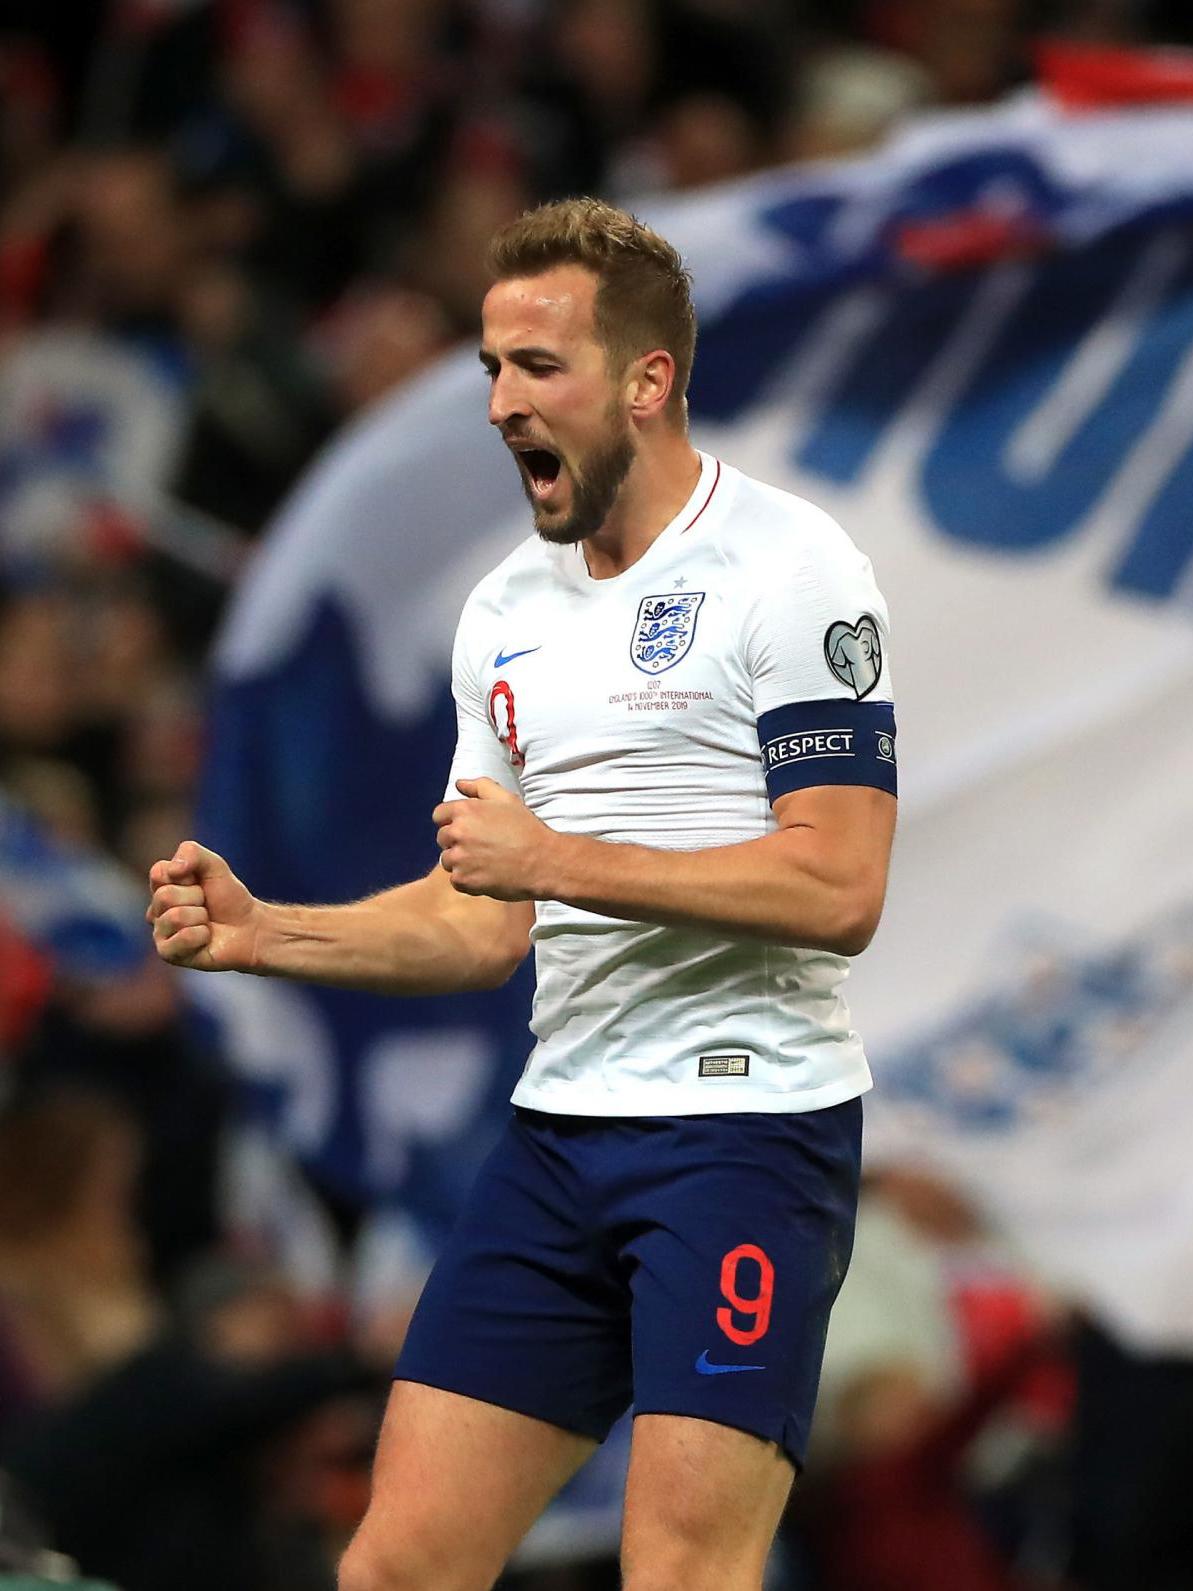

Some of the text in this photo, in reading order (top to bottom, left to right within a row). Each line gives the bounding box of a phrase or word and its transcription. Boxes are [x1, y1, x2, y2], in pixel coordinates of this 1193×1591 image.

[634, 701, 669, 710] NOVEMBER
[671, 701, 688, 710] 2019
[659, 690, 714, 701] INTERNATIONAL
[768, 734, 854, 764] RESPECT
[716, 1243, 775, 1346] 9
